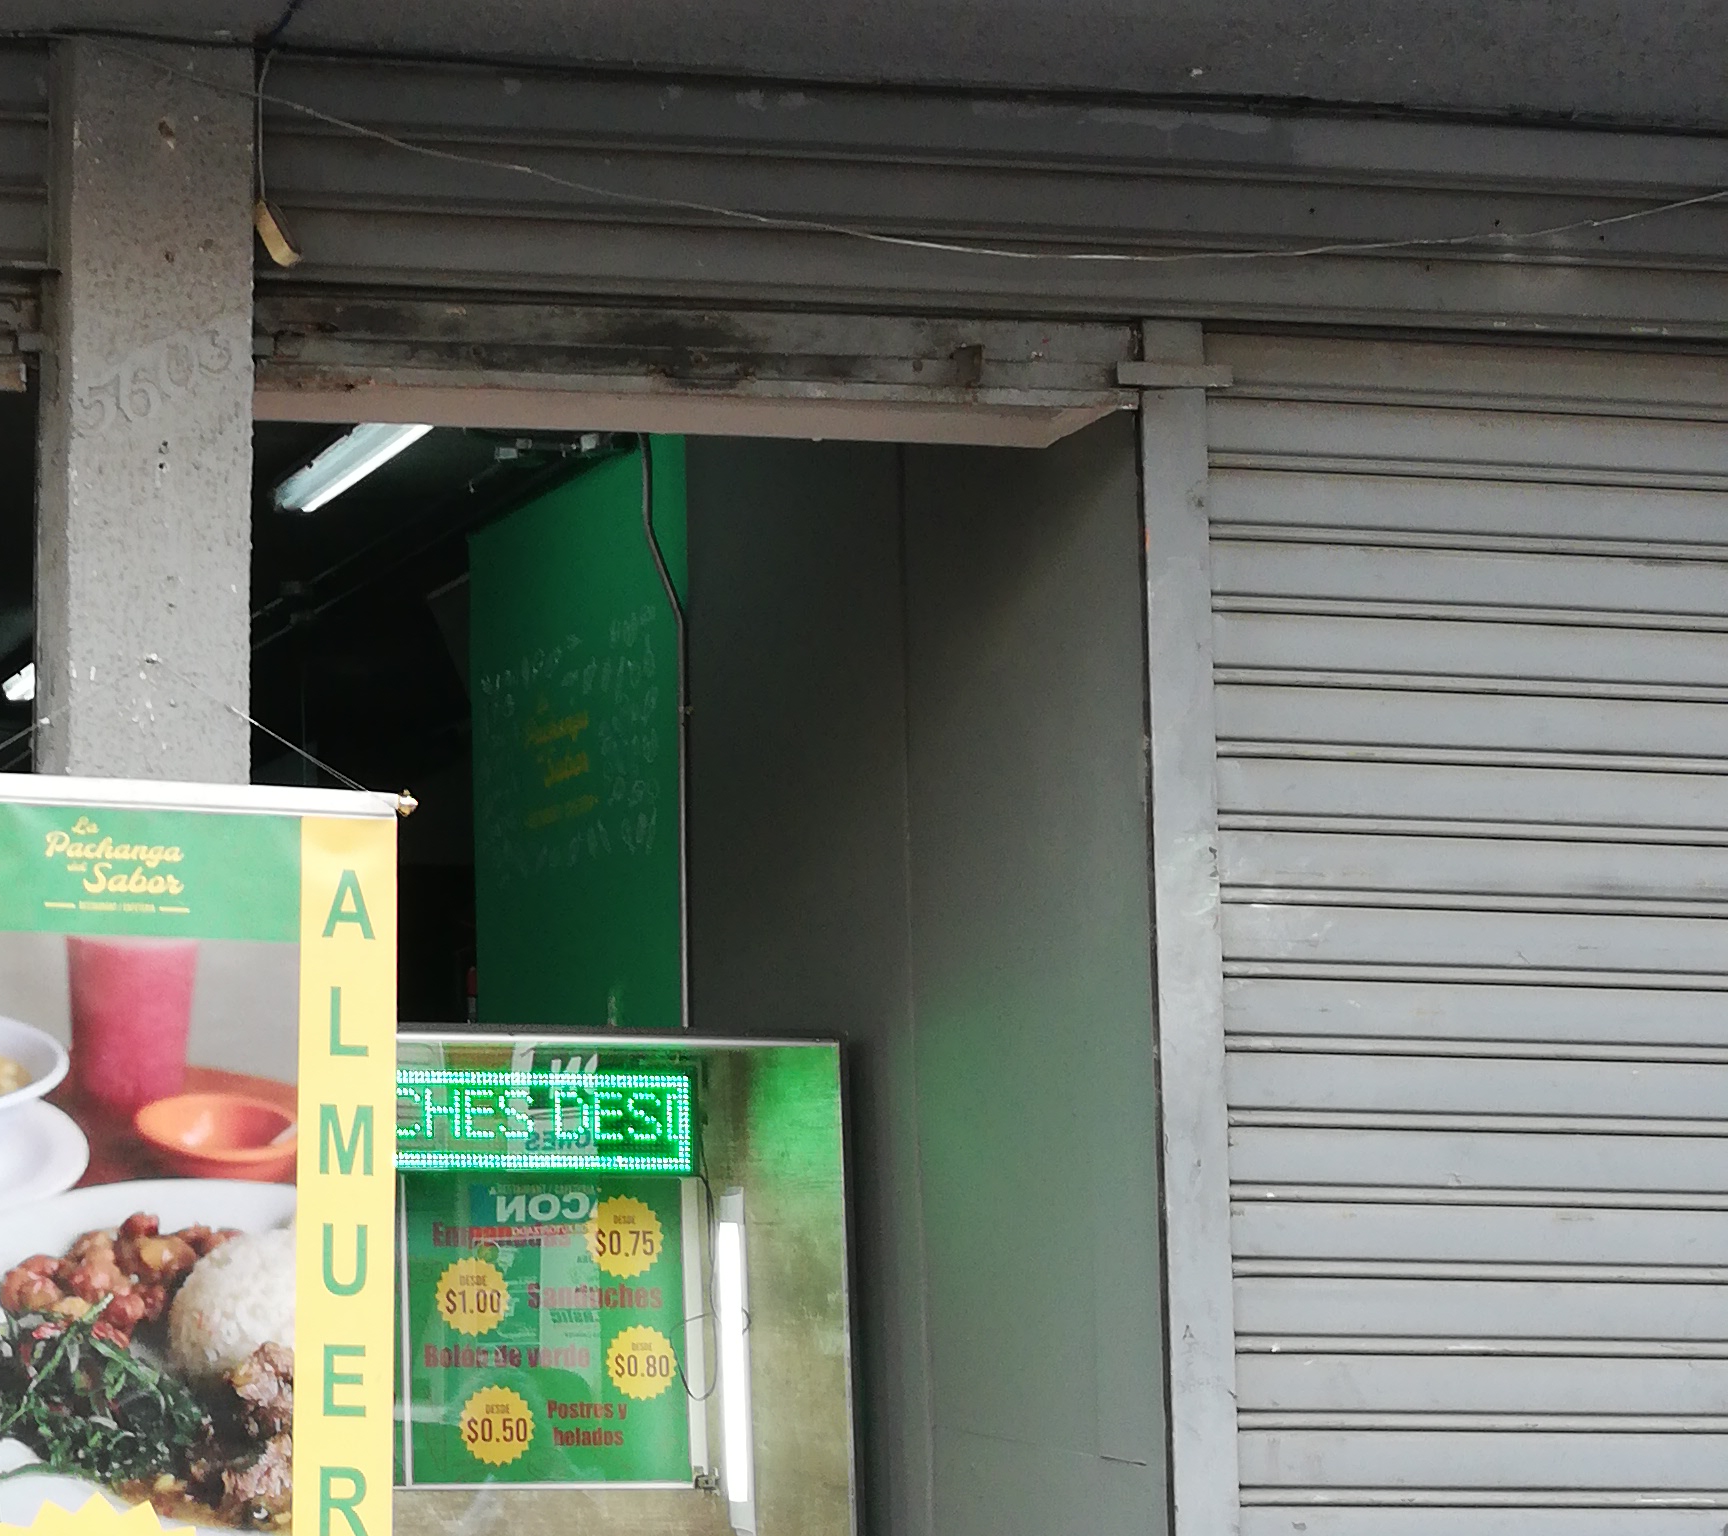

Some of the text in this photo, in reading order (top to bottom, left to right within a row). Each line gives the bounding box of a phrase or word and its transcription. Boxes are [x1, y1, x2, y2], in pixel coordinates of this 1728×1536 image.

[45, 830, 185, 868] Pachanga
[82, 861, 185, 896] Sabor
[594, 1228, 655, 1257] $0.75
[445, 1289, 501, 1315] $1.00
[614, 1353, 670, 1378] $0.80
[547, 1400, 614, 1420] Postres
[467, 1417, 528, 1444] $0.50
[552, 1426, 625, 1447] helados
